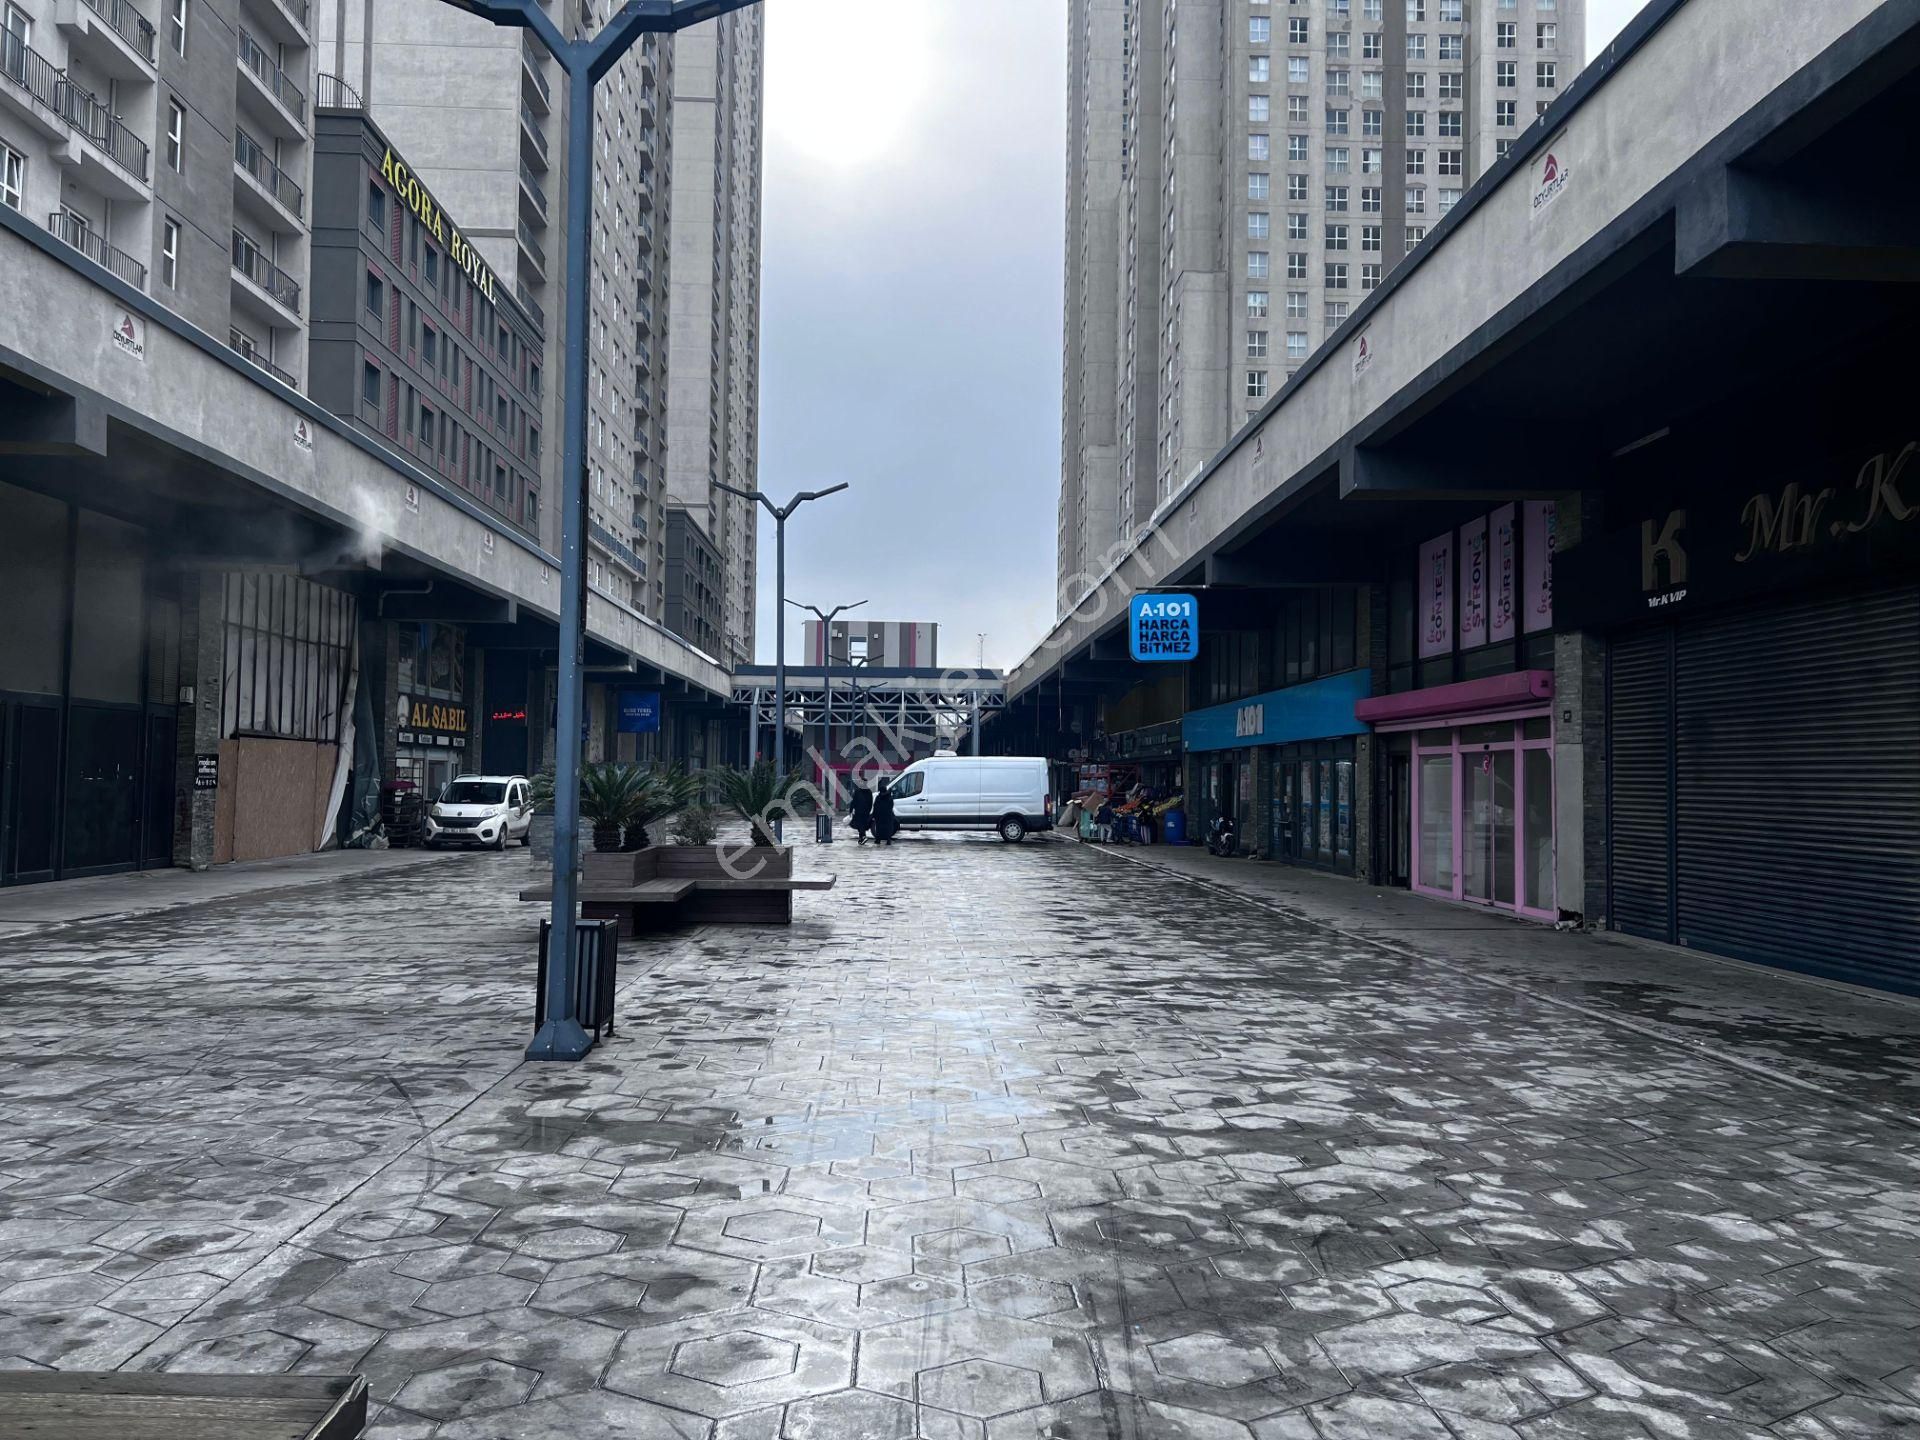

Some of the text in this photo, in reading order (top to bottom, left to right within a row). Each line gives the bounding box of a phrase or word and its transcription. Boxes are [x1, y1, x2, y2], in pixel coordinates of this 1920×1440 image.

[380, 148, 496, 305] AGORA ROYAL
[1434, 552, 1443, 643] CONTENT
[1473, 535, 1482, 628] STRONG
[1502, 524, 1511, 624] YOURSELF
[1669, 589, 1687, 603] VIP
[1139, 619, 1190, 630] HARCA
[1139, 631, 1190, 642] HARCA
[411, 702, 467, 732] AL SABIL
